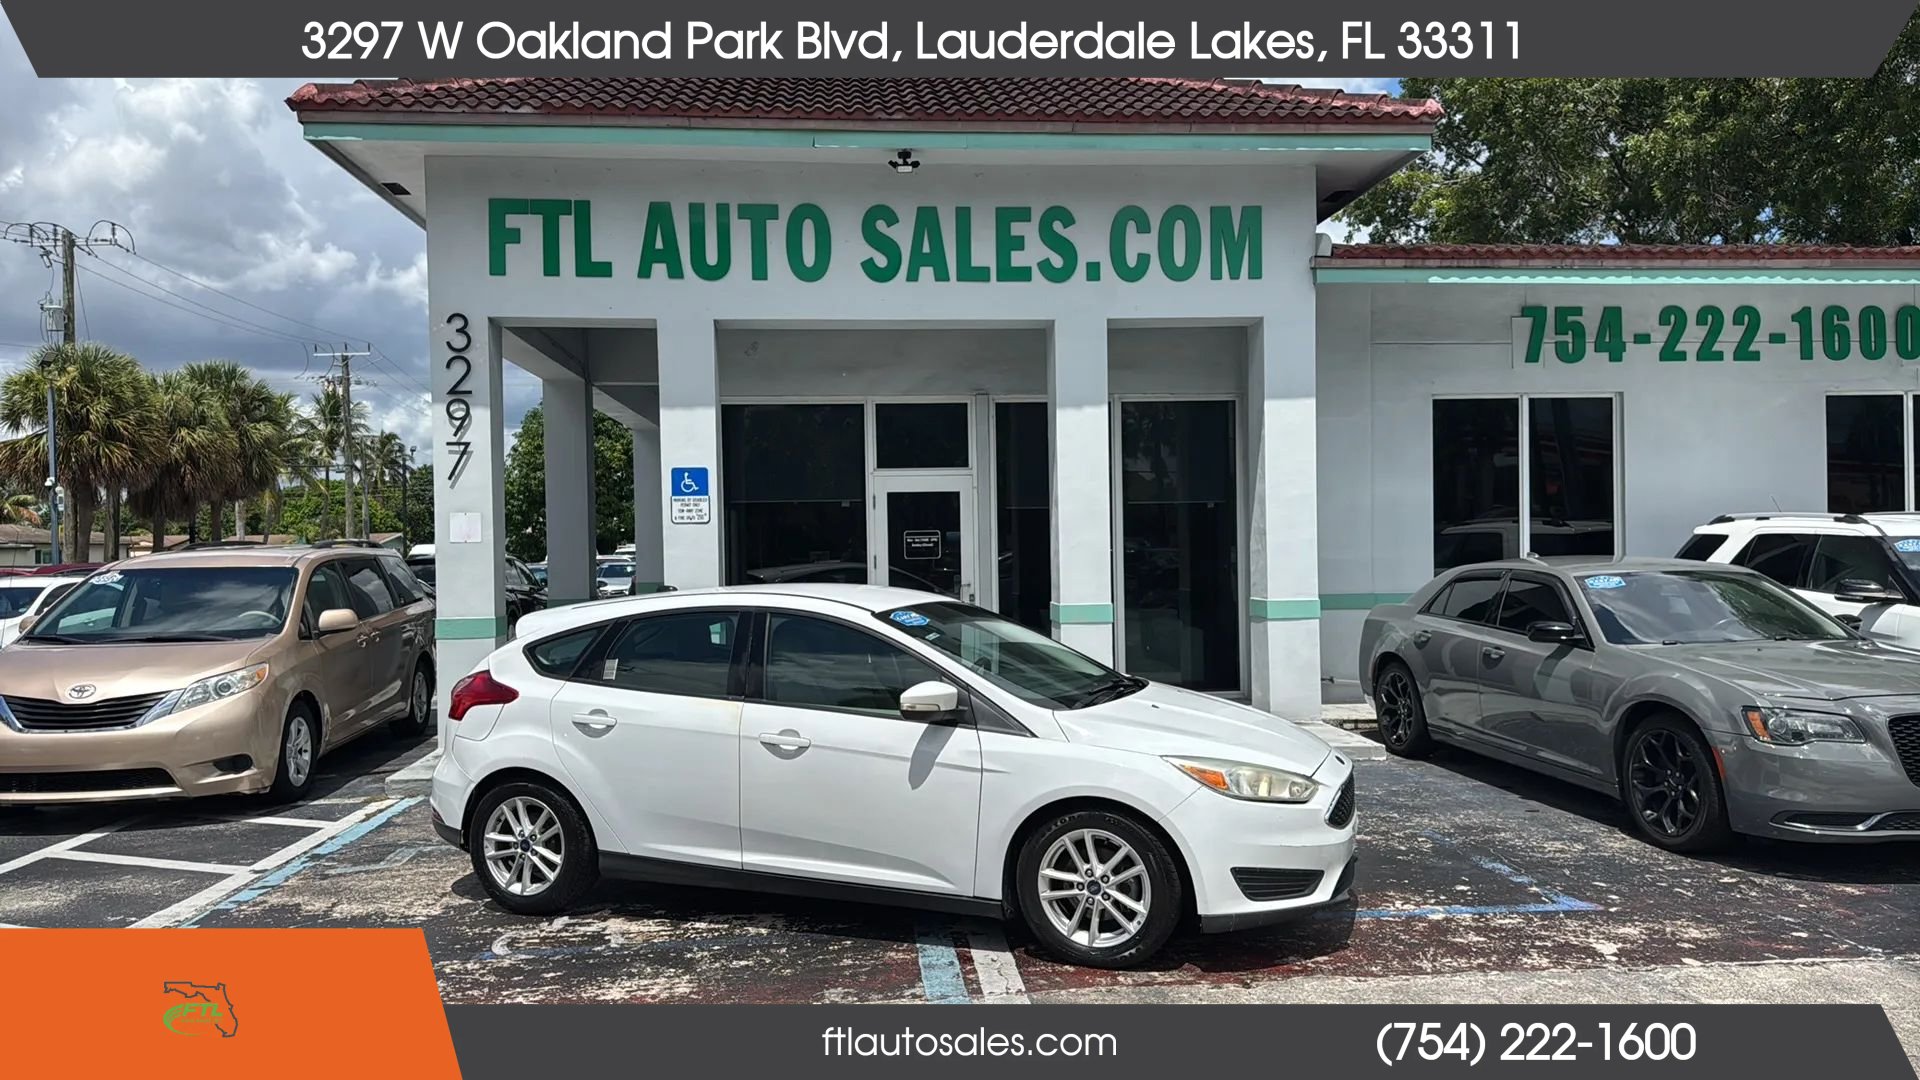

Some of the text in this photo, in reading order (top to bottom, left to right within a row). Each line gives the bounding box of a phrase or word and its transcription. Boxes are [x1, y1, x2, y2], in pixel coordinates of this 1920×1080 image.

[489, 199, 1264, 285] FTL AUTO SALES.COM
[1521, 304, 1920, 364] 754-222-1600
[445, 312, 473, 482] 3297
